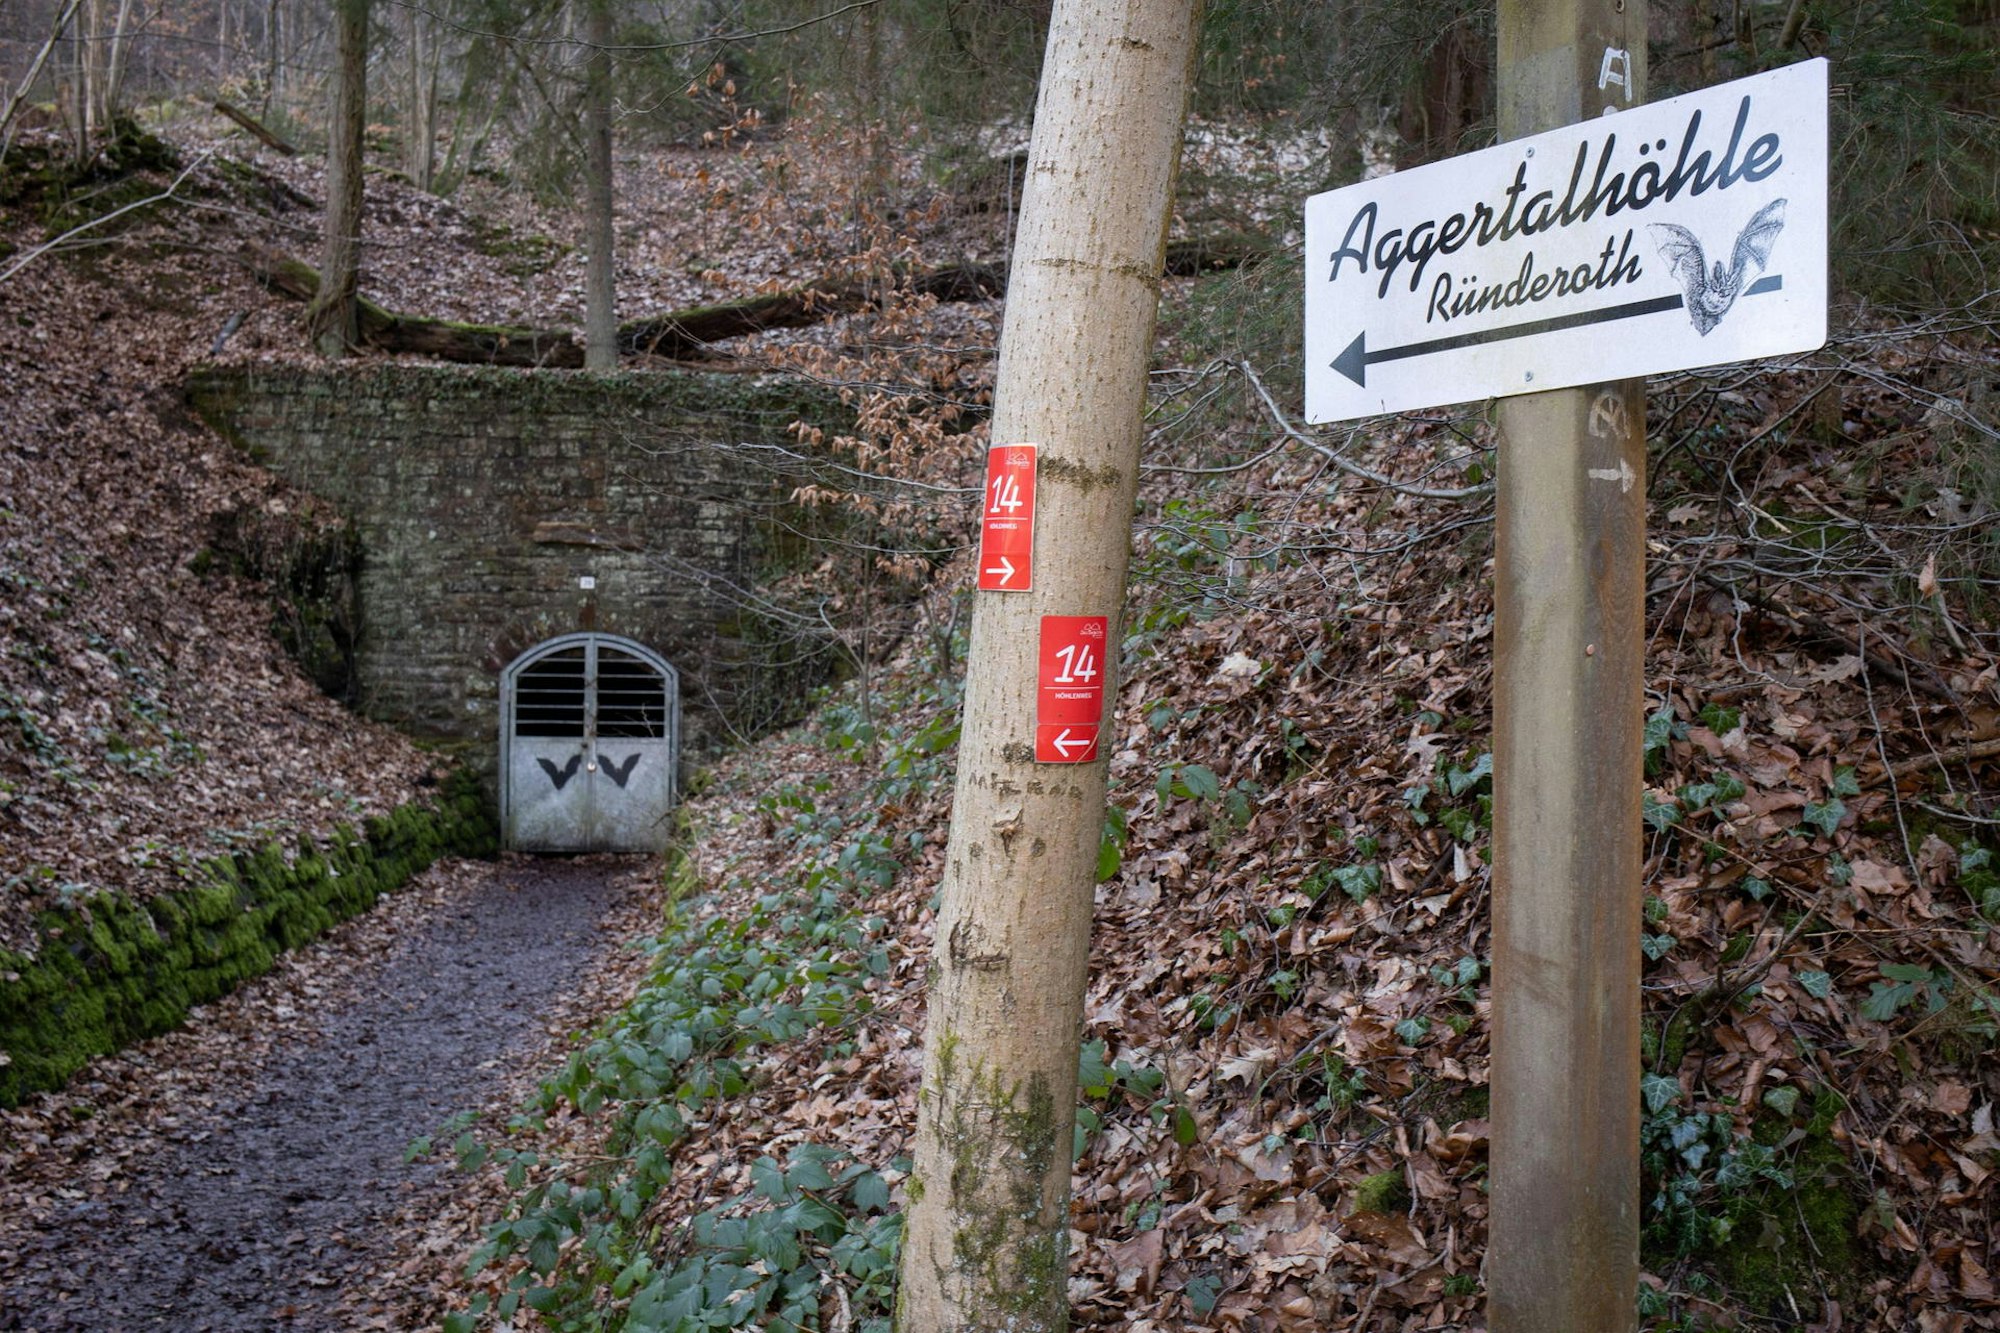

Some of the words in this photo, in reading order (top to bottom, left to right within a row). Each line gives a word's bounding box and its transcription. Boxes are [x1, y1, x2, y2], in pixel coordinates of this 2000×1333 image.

[1328, 94, 1783, 299] Aggertalhöhle
[1426, 228, 1643, 324] Ründeroth
[990, 474, 1023, 514] 14
[1054, 644, 1097, 683] 14
